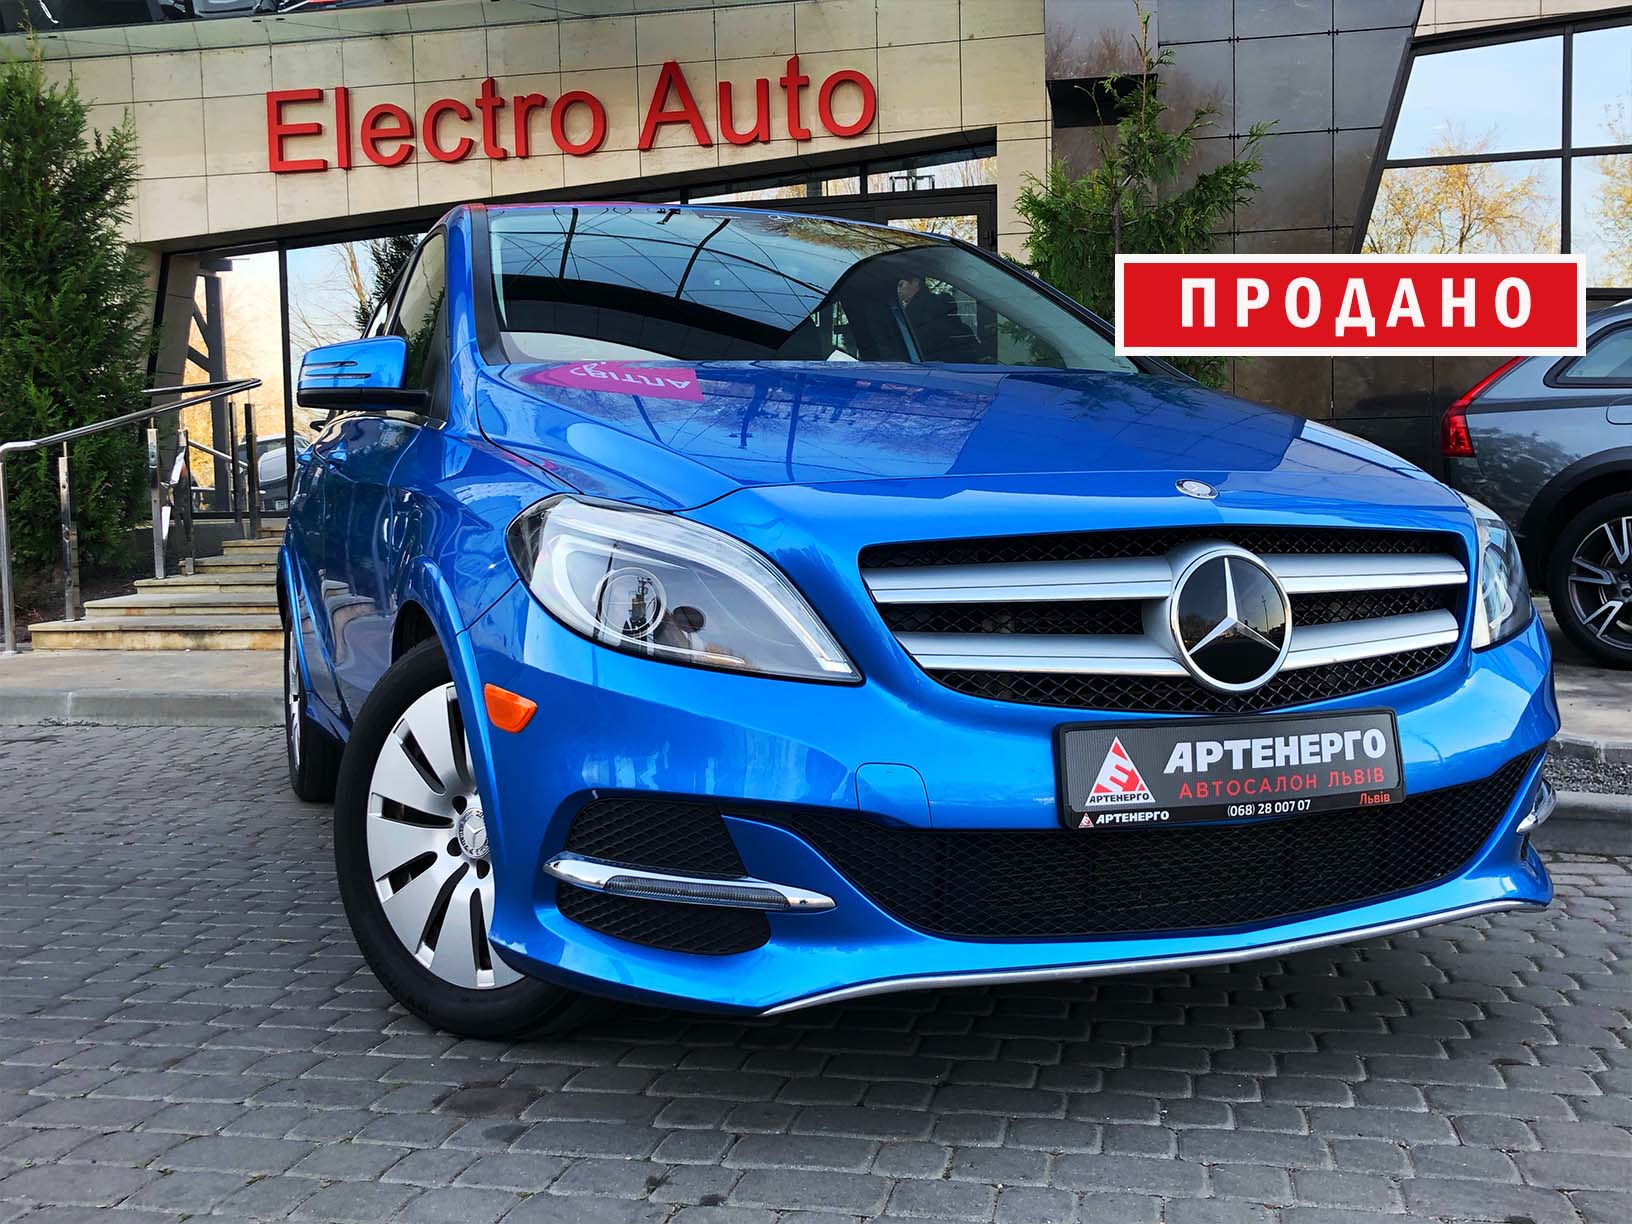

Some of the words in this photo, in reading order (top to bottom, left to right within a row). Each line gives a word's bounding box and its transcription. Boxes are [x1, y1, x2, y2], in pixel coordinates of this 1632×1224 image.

[266, 76, 608, 173] Electro
[638, 53, 877, 150] Auto
[1163, 728, 1387, 774] АРТЕНЕРГО
[1178, 772, 1318, 799] АВТОСАЛОН
[1327, 767, 1385, 788] ЛЬВІВ
[1089, 792, 1150, 804] АРТЕНЕРГО
[1359, 790, 1391, 805] Львів
[1096, 810, 1170, 824] АРТЕНЕРГО
[1227, 803, 1256, 818] (068)
[1258, 802, 1271, 815] 28
[1274, 801, 1295, 813] 007
[1297, 799, 1311, 812] 07
